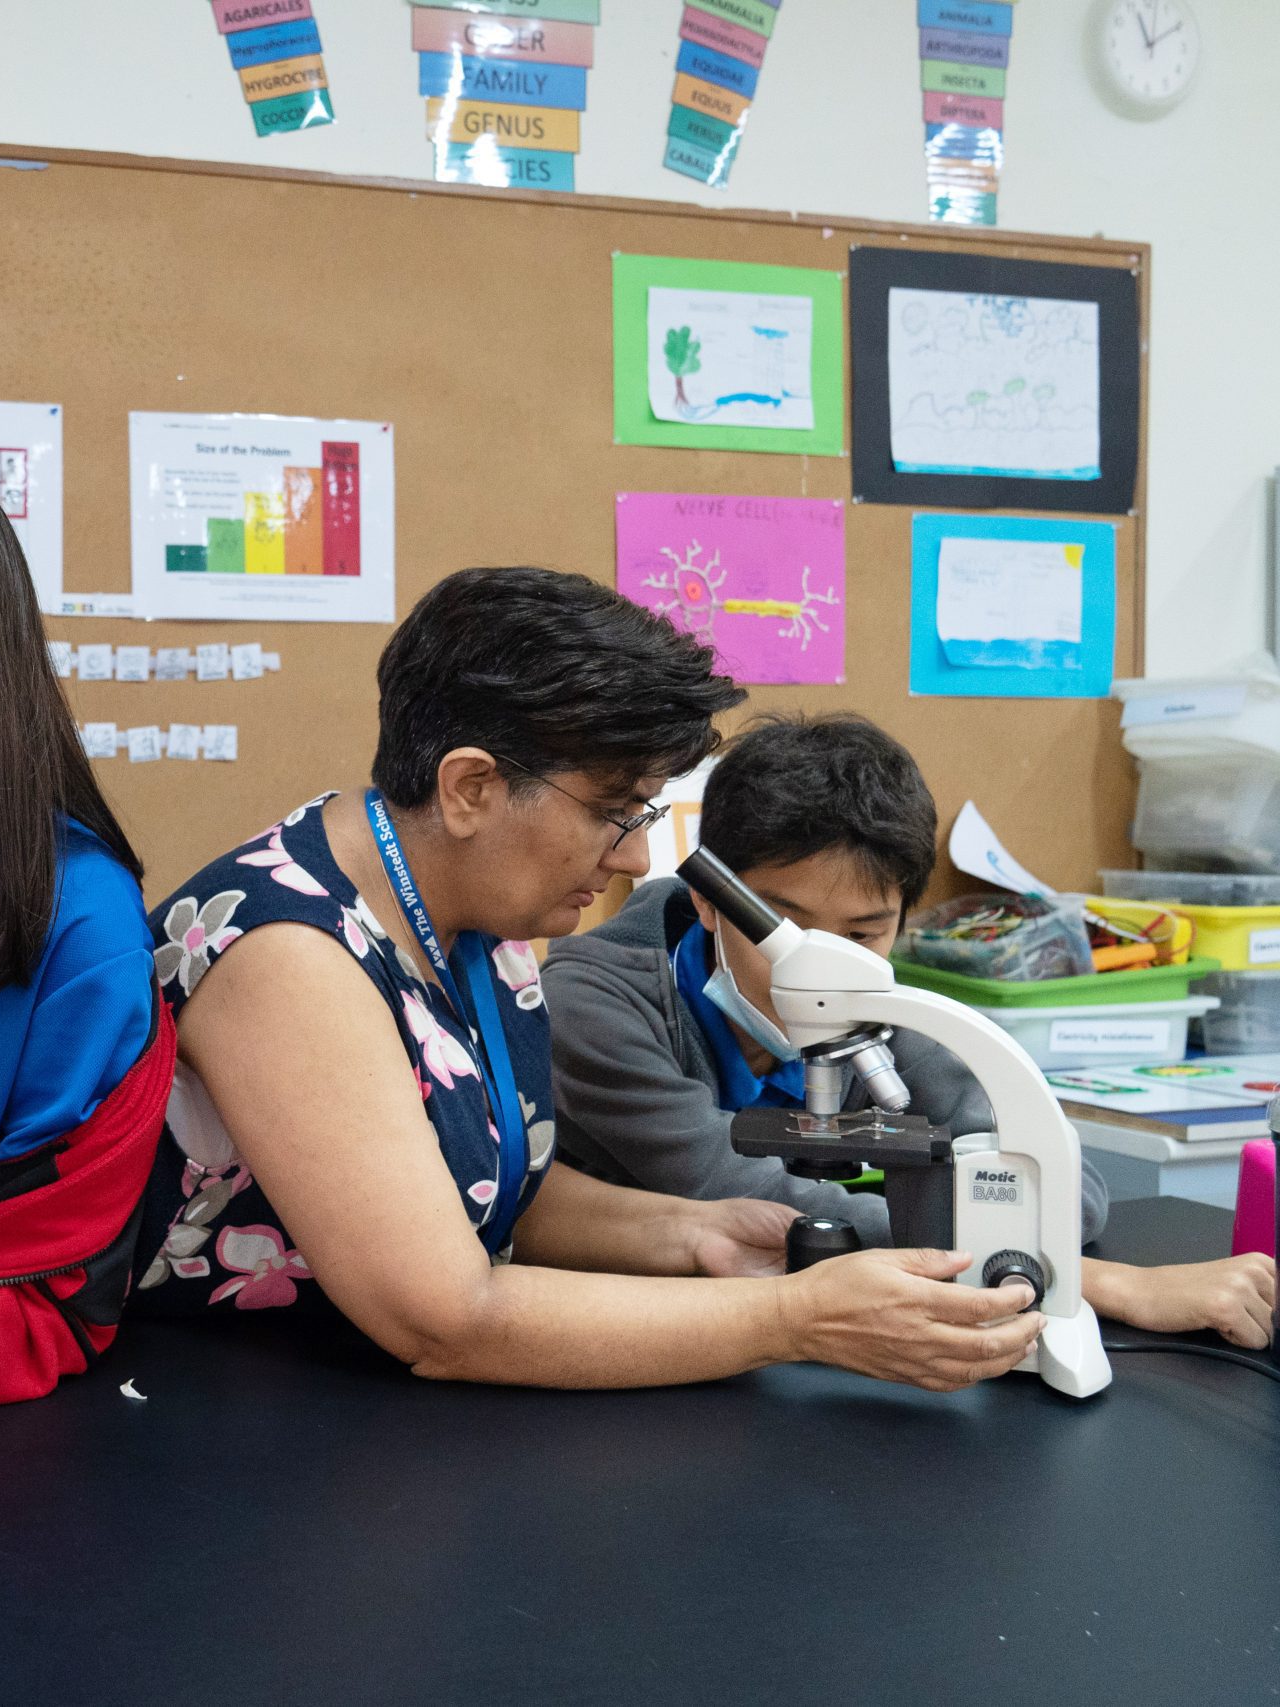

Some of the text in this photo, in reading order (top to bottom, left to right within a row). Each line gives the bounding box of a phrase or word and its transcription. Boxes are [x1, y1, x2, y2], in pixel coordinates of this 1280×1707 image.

[223, 1, 304, 24] AGARICALES
[463, 67, 548, 95] FAMILY
[941, 74, 986, 91] INSECTA
[691, 90, 732, 115] EQUUS
[464, 111, 545, 139] GENUS
[196, 442, 291, 457] Size of the Problem
[370, 799, 431, 936] The Winstedt School
[974, 1170, 1017, 1183] Motic
[973, 1185, 1017, 1202] BA80
